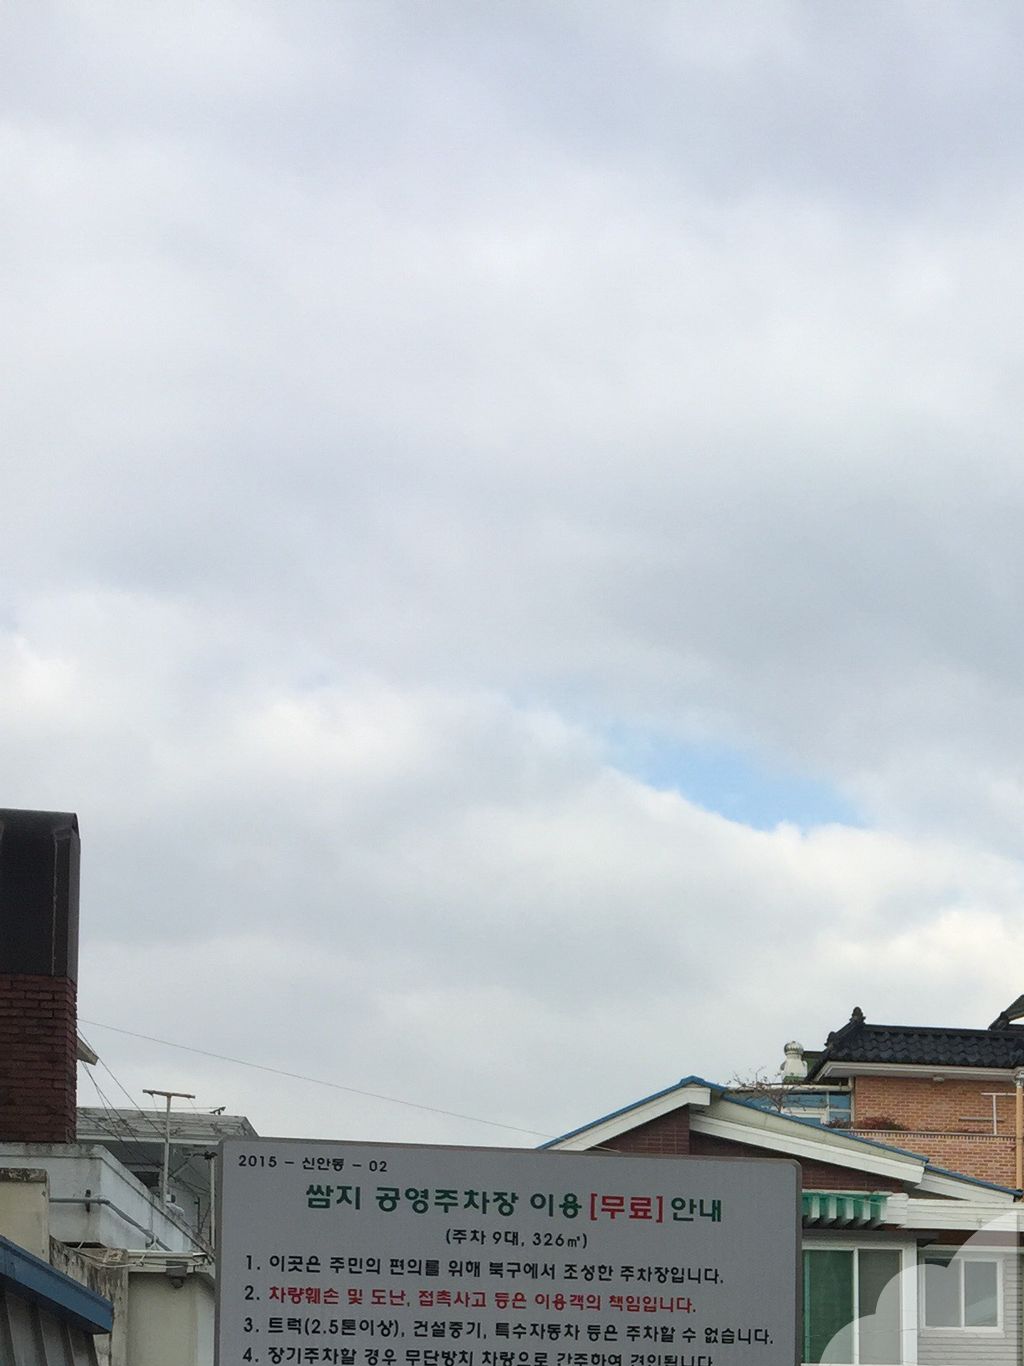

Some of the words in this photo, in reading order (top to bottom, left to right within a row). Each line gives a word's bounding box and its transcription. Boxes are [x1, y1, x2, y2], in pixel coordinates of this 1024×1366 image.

[238, 1155, 278, 1168] 2015
[301, 1156, 345, 1172] 신안동
[368, 1159, 388, 1173] 02
[305, 1184, 361, 1211] 쌈지
[375, 1186, 520, 1217] 공영주차장
[445, 1227, 487, 1246] (주차
[492, 1230, 525, 1248] 9대,
[245, 1254, 261, 1271] 1.
[269, 1255, 322, 1274] 이곳은
[329, 1256, 381, 1276] 주민의
[389, 1258, 440, 1277] 편의를
[447, 1259, 481, 1278] 위해
[488, 1261, 556, 1281] 북구에서
[563, 1263, 614, 1282] 조성한
[619, 1265, 724, 1285] 주차장입니다.
[244, 1284, 261, 1301] 2.
[268, 1285, 340, 1305] 차량훼손
[347, 1288, 363, 1305] 및
[370, 1288, 411, 1308] 도난,
[418, 1289, 487, 1308] 접촉사고
[494, 1291, 527, 1310] 등은
[534, 1293, 601, 1312] 이용객의
[608, 1294, 696, 1314] 책임입니다.
[243, 1316, 260, 1333] 3.
[413, 1320, 487, 1340] 건설중기,
[494, 1322, 581, 1342] 특수자동차
[586, 1324, 619, 1342] 등은
[625, 1324, 676, 1344] 주차할
[681, 1327, 697, 1344] 수
[704, 1327, 774, 1345] 없습니다.
[242, 1346, 259, 1363] 4.
[267, 1346, 358, 1366] 장기주차할
[364, 1348, 398, 1366] 경우
